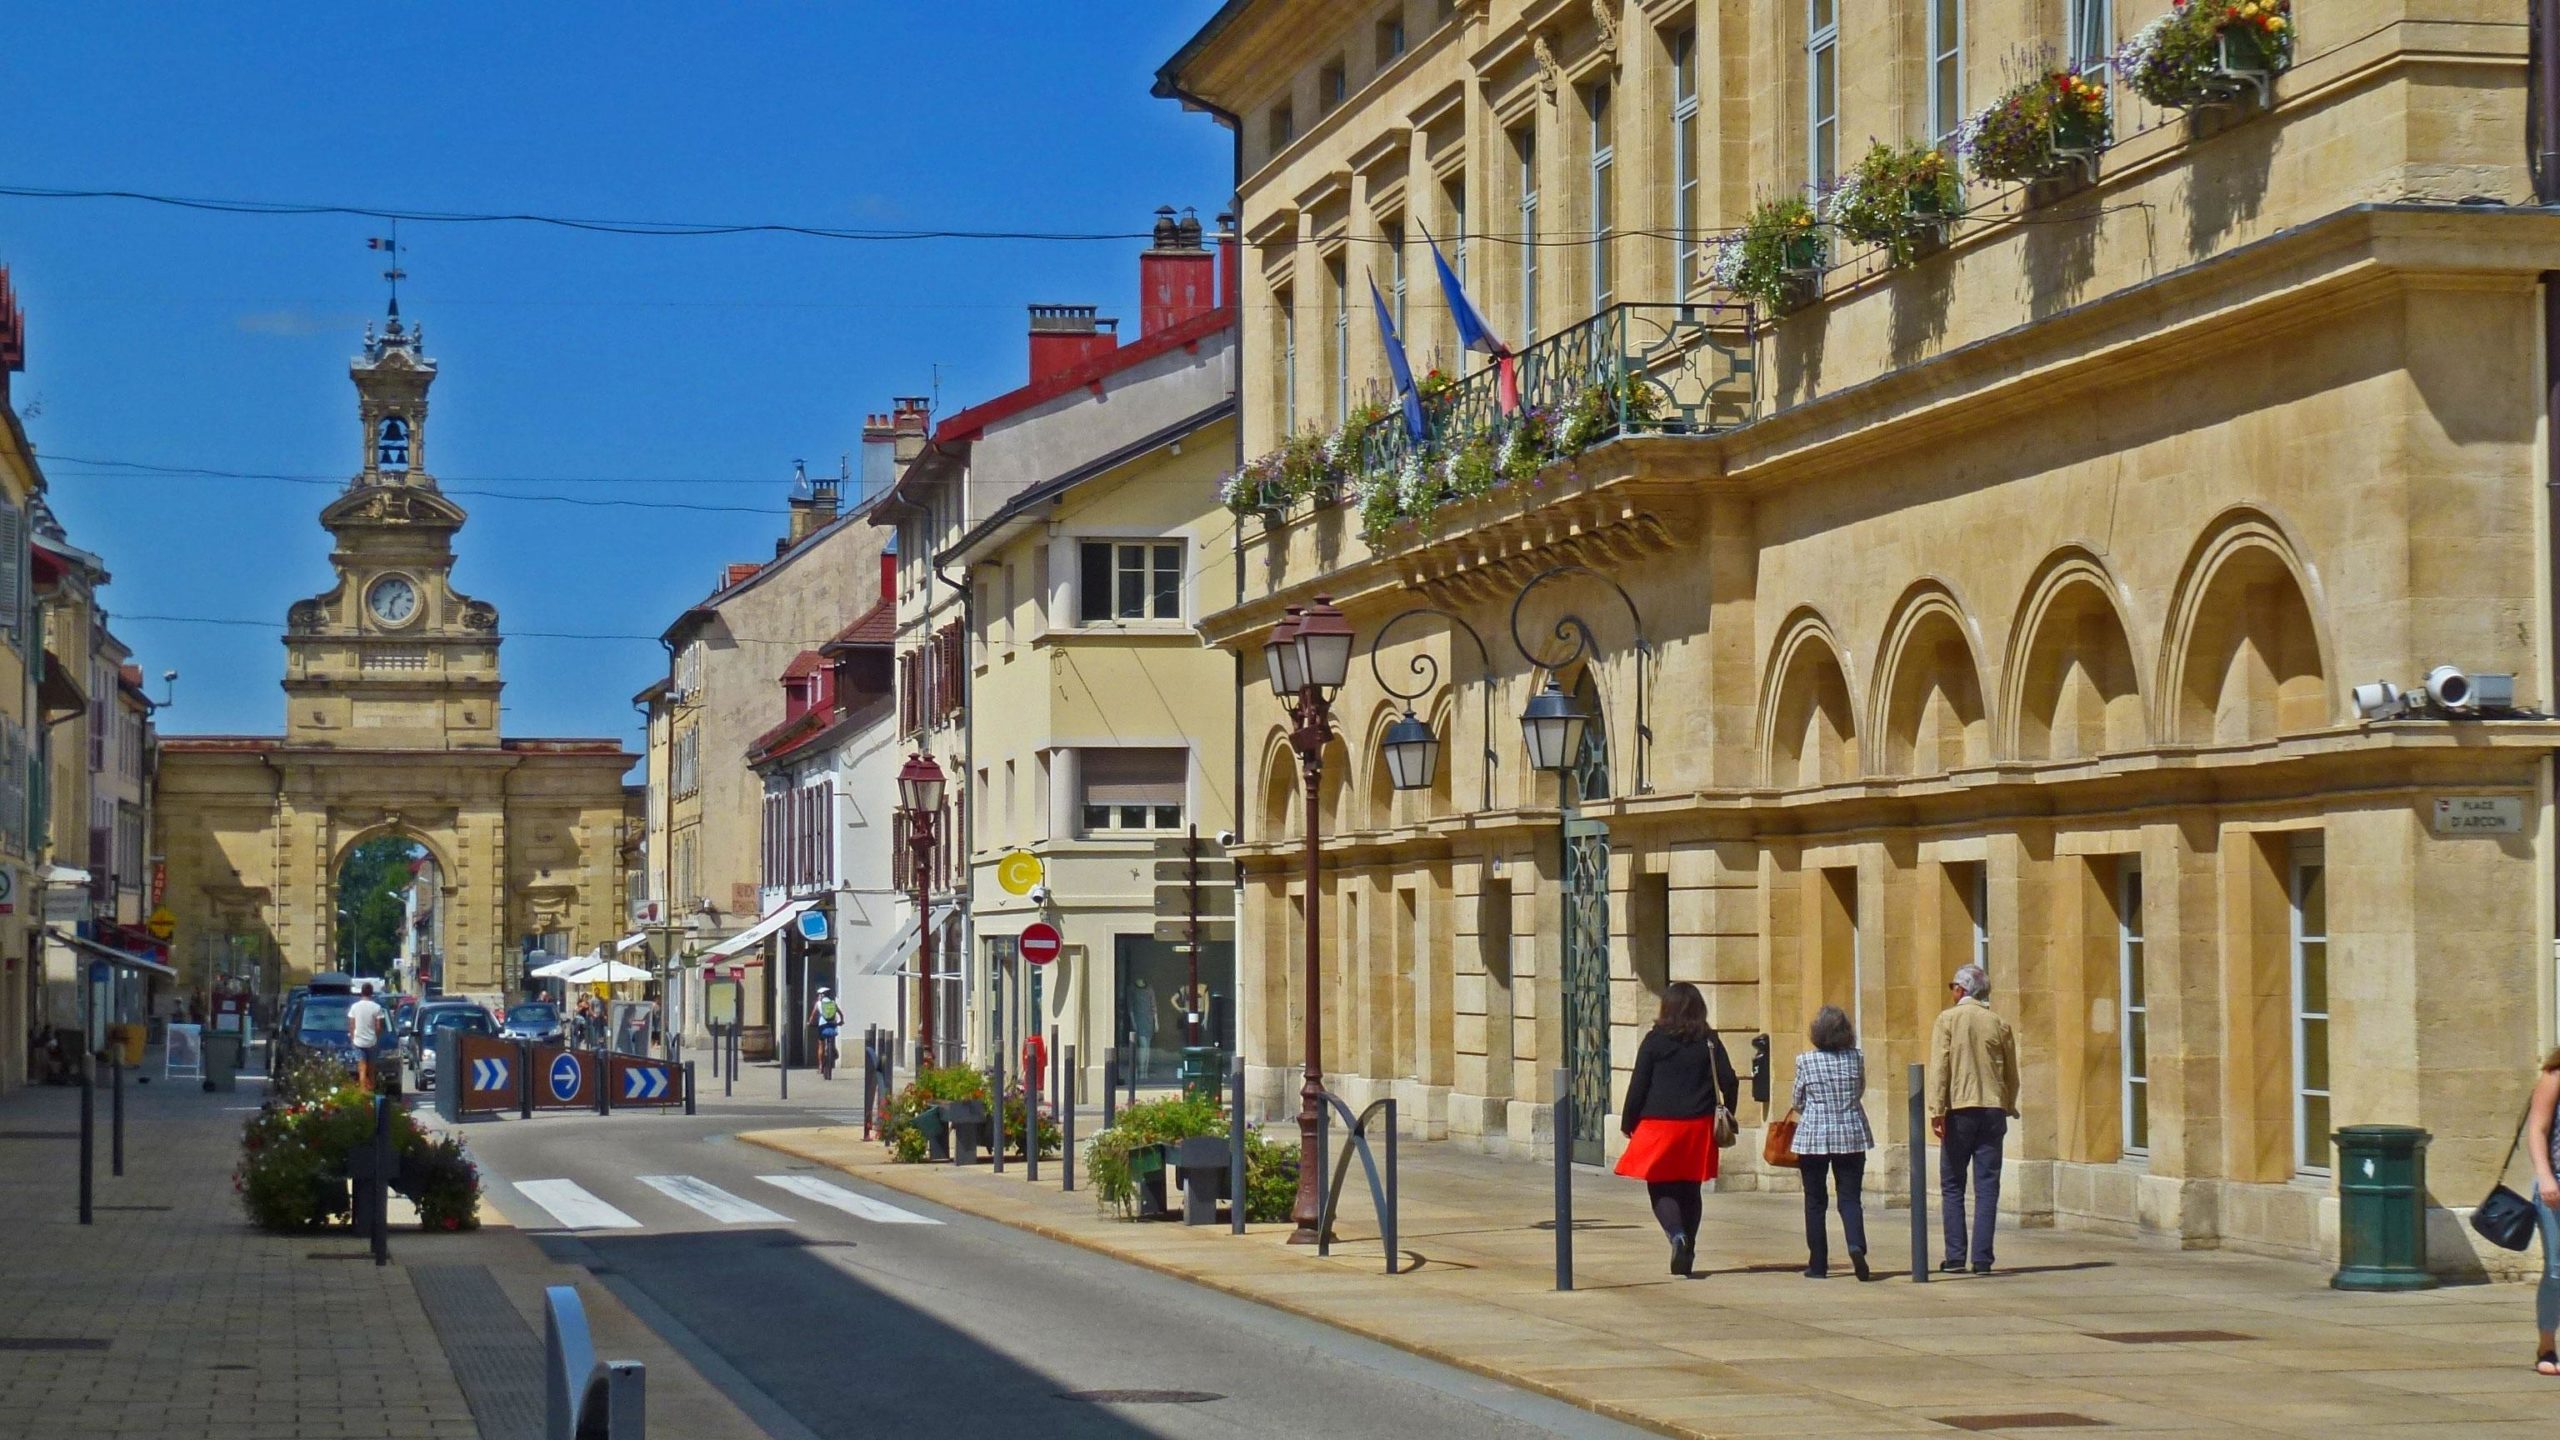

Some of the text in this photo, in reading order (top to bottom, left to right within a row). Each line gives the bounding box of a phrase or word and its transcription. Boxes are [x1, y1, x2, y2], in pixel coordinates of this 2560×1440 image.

[2463, 801, 2494, 810] PLACE
[153, 864, 165, 904] TABAC
[1010, 863, 1029, 884] C
